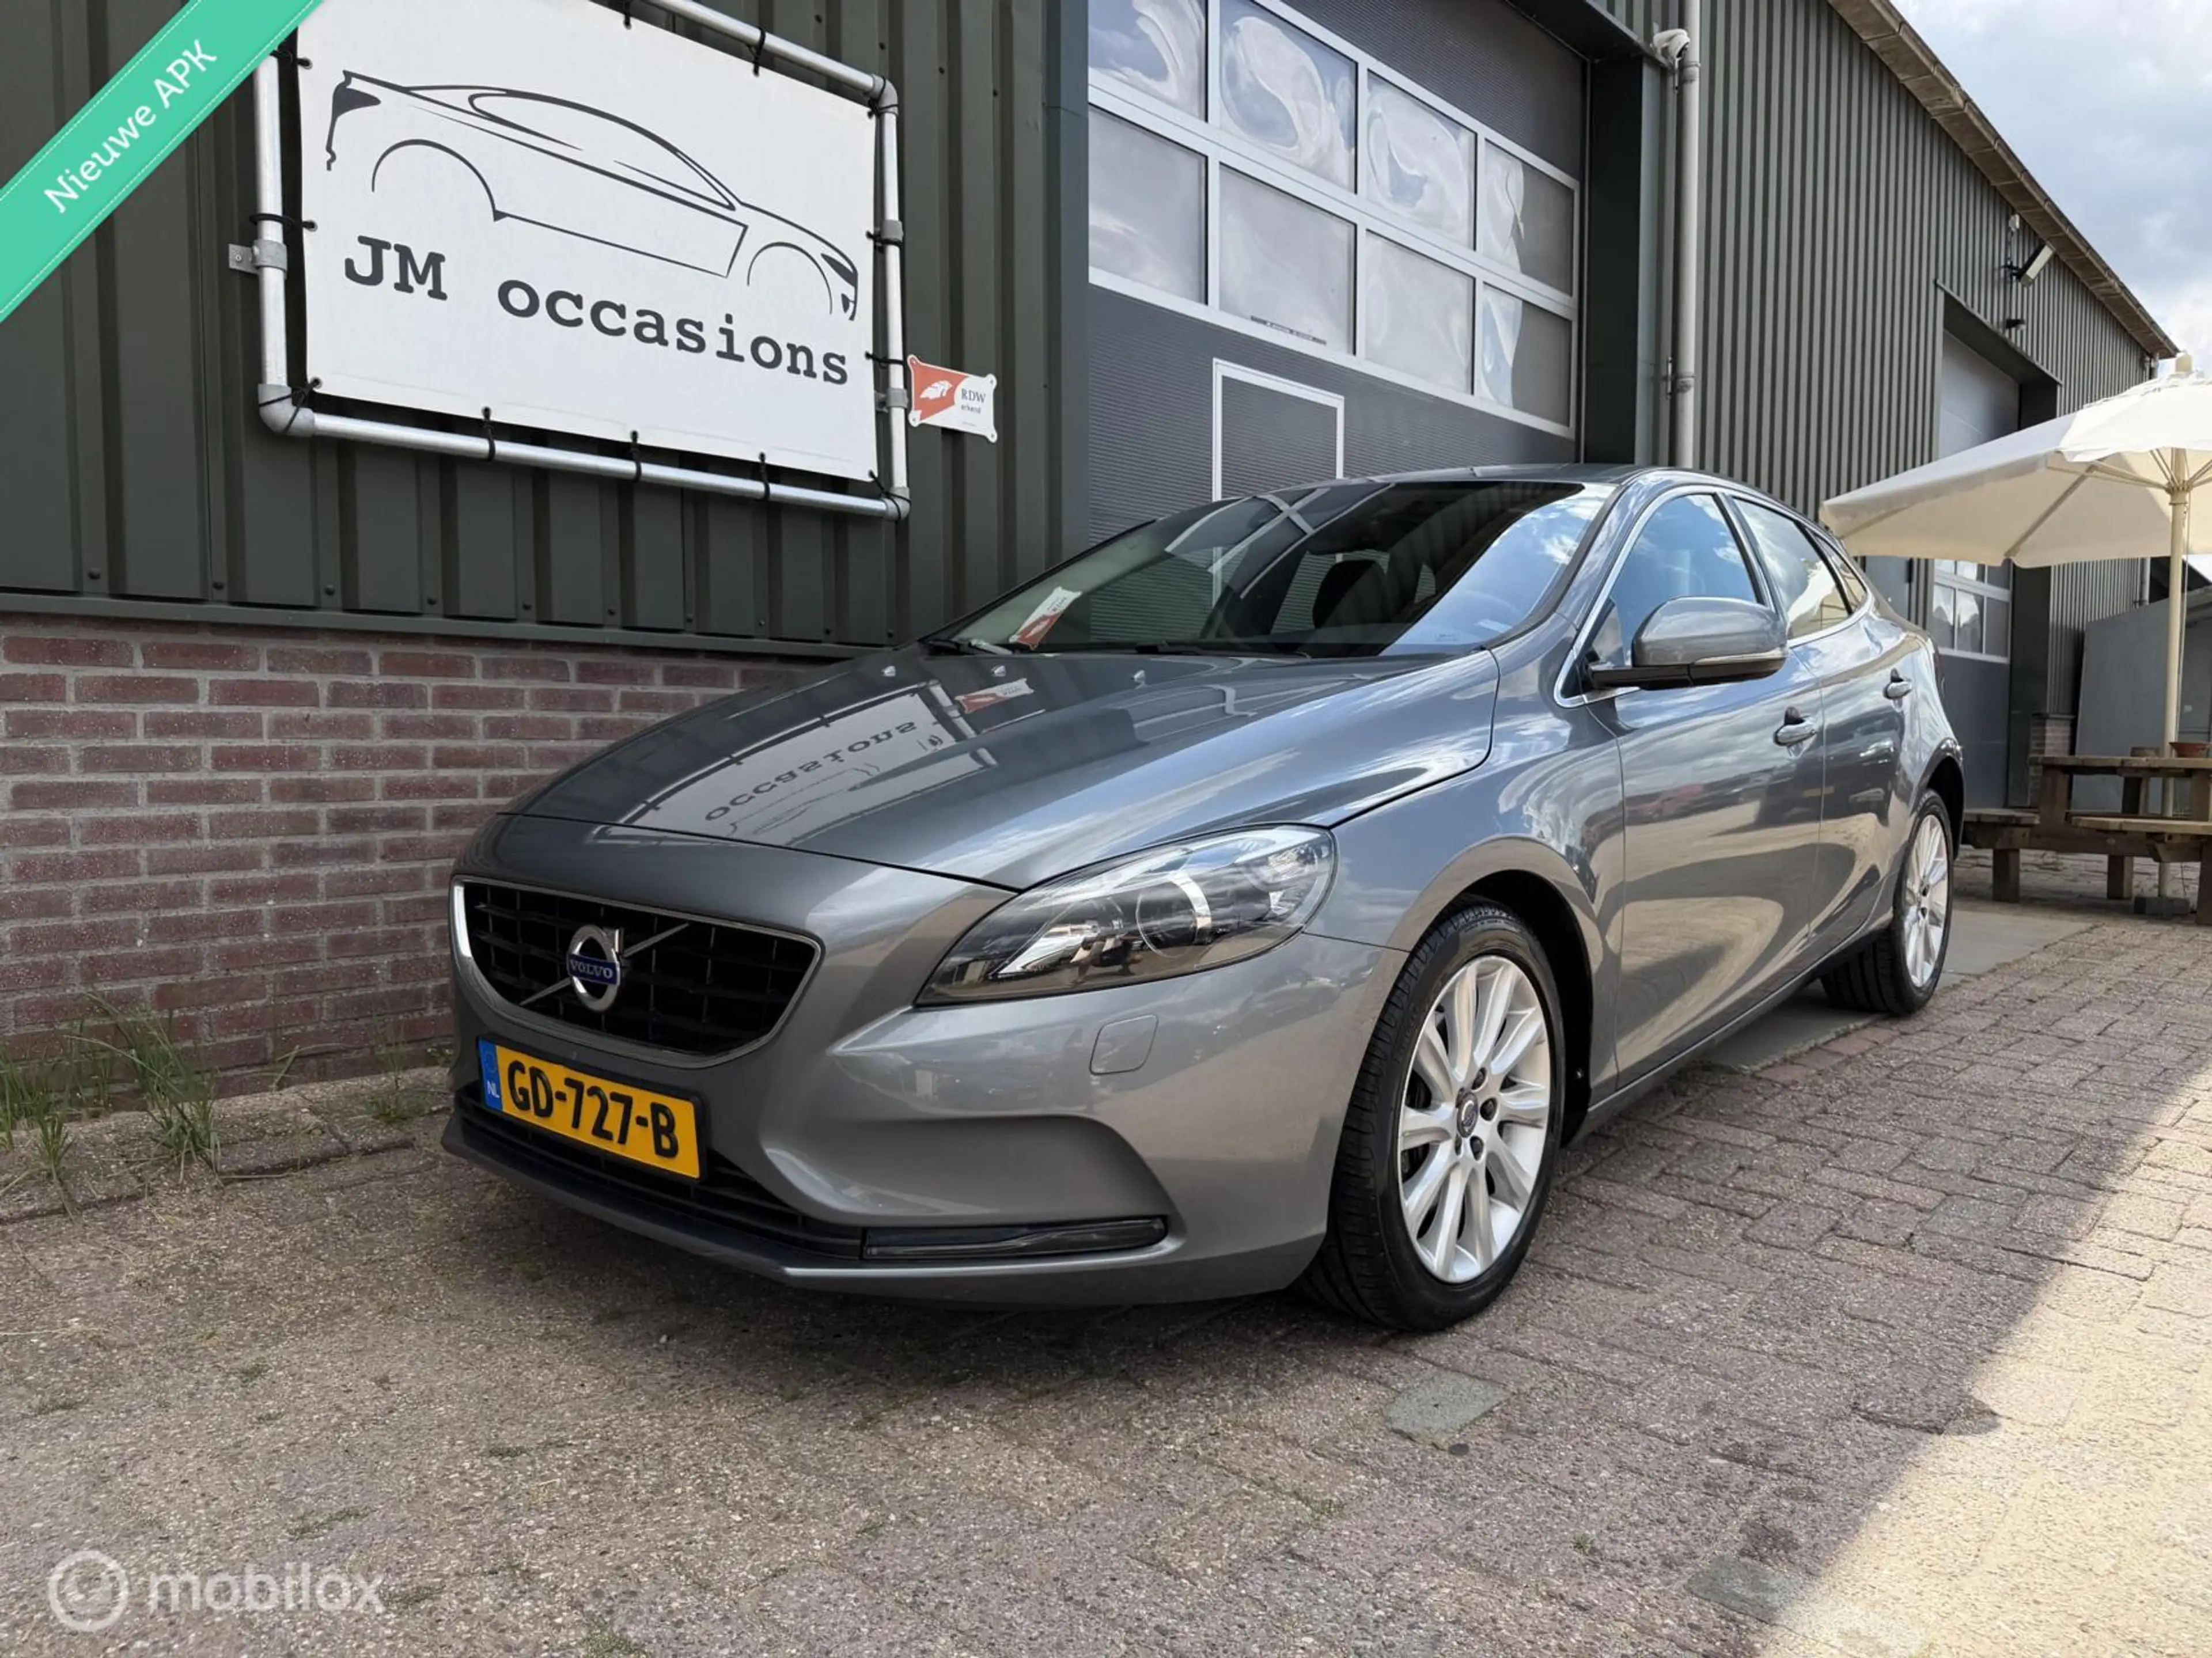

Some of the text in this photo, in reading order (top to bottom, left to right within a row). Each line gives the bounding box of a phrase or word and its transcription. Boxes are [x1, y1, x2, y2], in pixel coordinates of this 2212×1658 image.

[344, 235, 849, 385] JM occasions
[961, 388, 986, 404] RDW
[570, 959, 613, 979] VOLVO
[487, 1060, 679, 1159] NL GD-727-B
